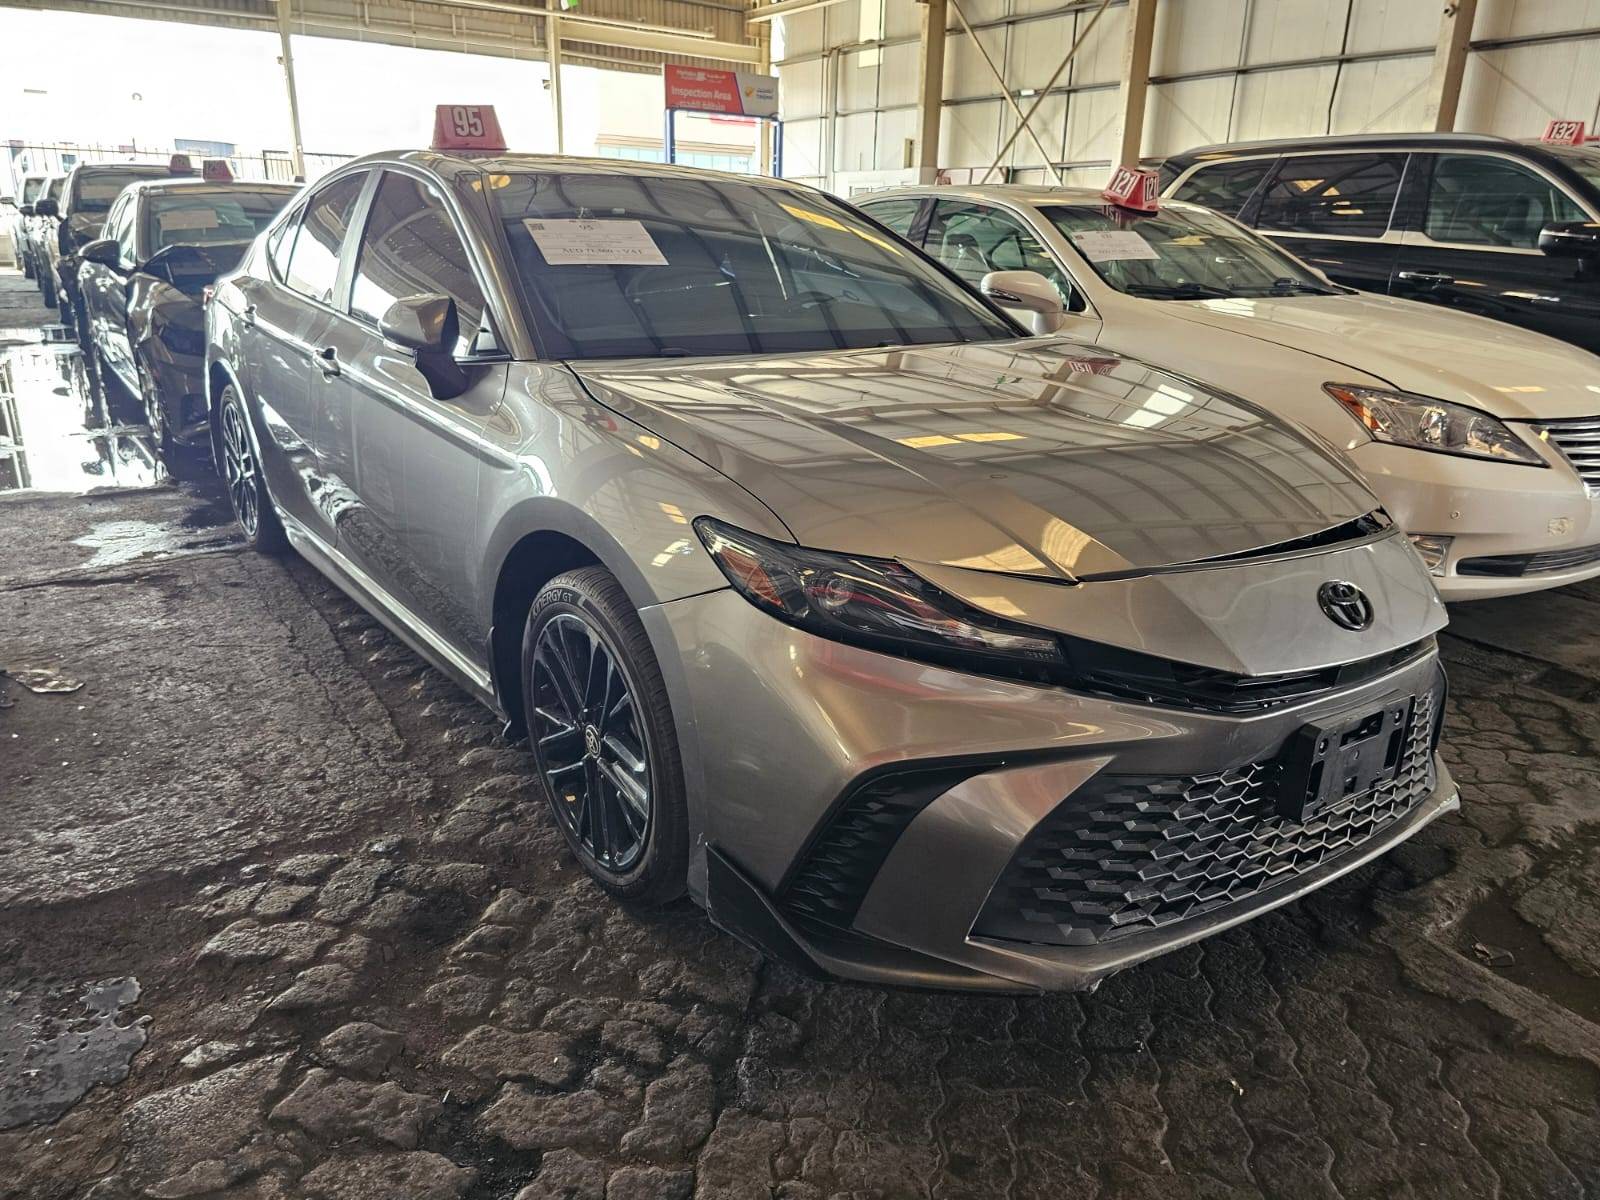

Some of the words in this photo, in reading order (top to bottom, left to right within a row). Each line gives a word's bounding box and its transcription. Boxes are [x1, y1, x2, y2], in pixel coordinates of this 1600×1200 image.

[671, 86, 713, 99] Inspection
[713, 90, 732, 101] Area
[453, 106, 483, 136] 95
[1551, 122, 1576, 139] 132
[1110, 169, 1138, 198] 121
[1146, 176, 1157, 201] 121
[562, 592, 573, 602] GT
